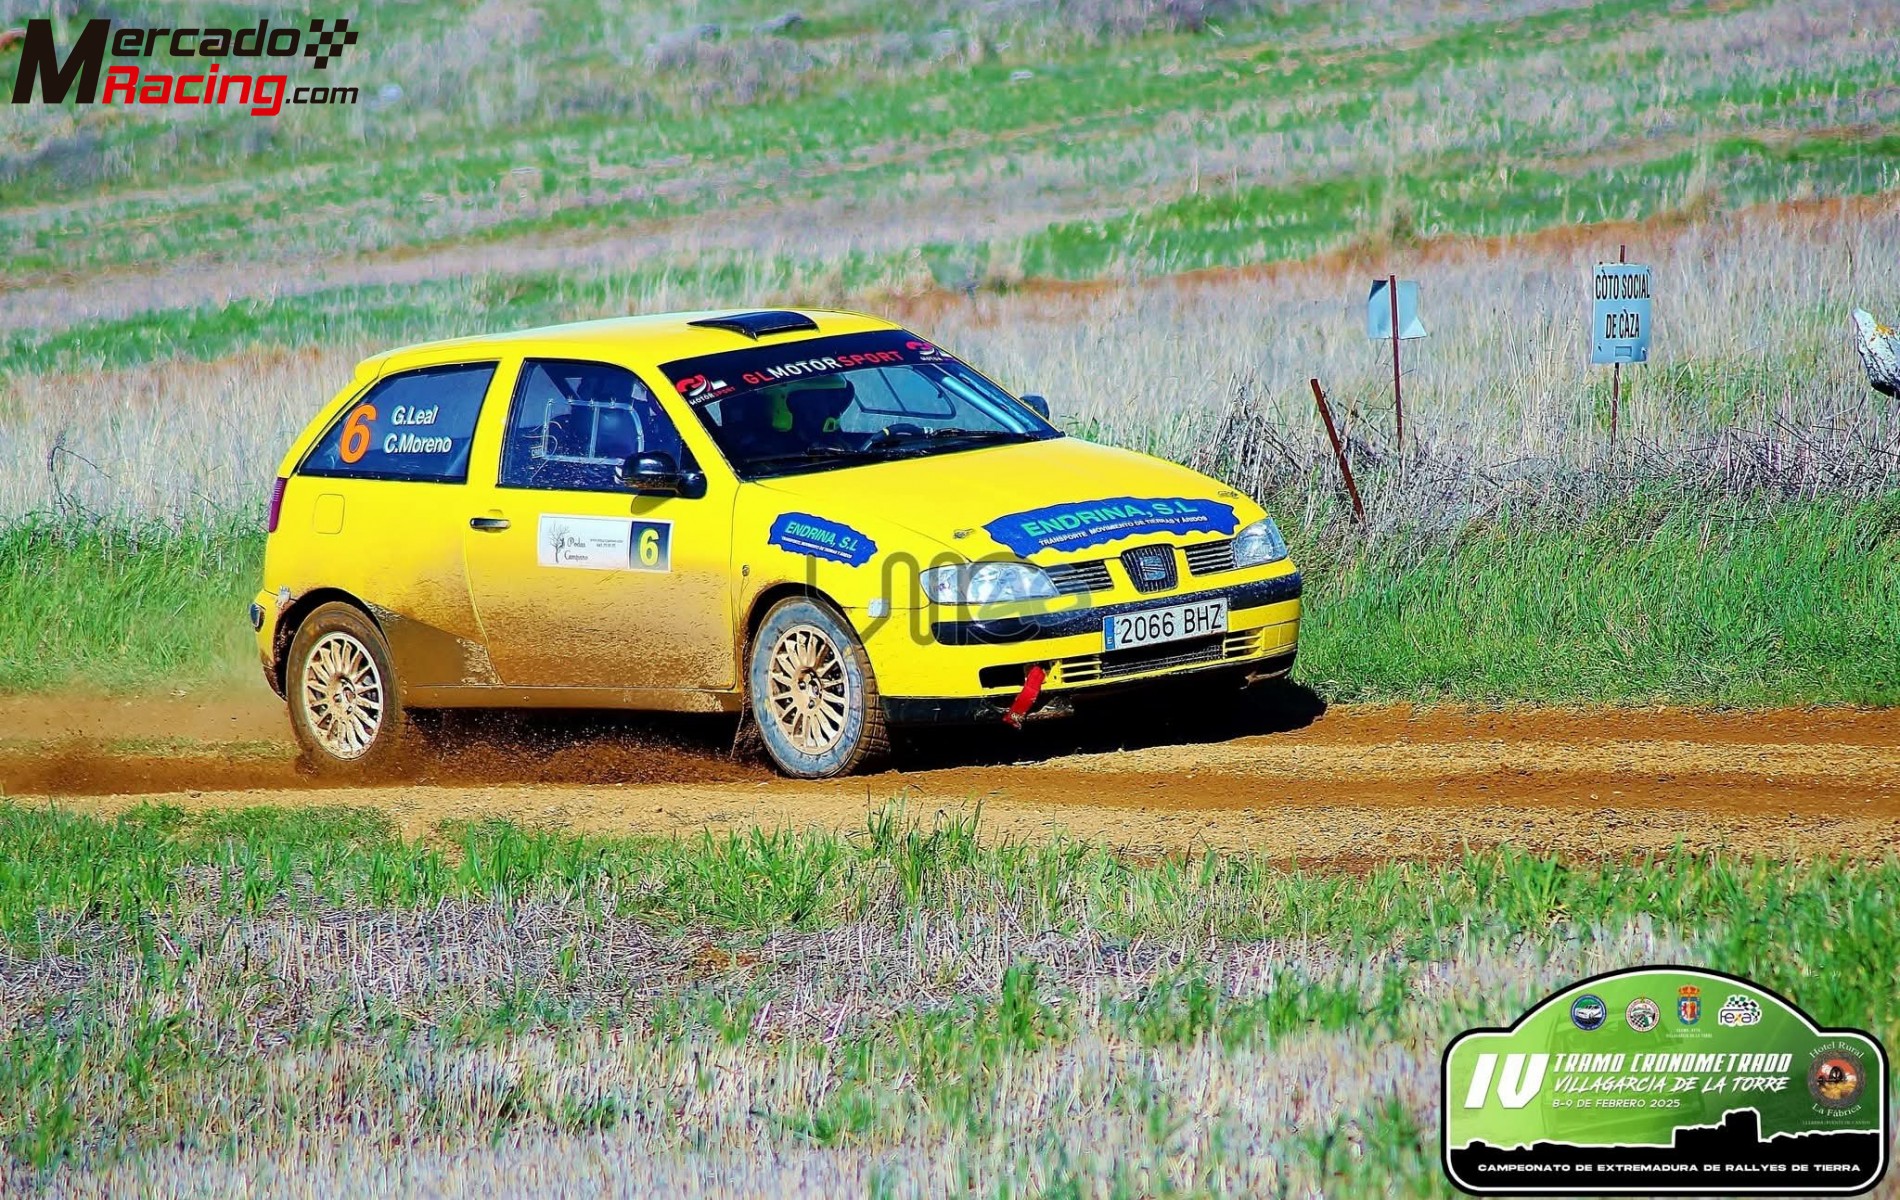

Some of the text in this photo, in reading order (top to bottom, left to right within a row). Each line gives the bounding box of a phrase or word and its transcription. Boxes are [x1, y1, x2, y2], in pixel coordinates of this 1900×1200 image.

[1622, 273, 1650, 299] SOCIAL
[1605, 313, 1617, 339] DE
[391, 404, 438, 426] G.Leal
[339, 402, 378, 465] 6
[384, 432, 453, 455] C.Moreno
[1038, 531, 1088, 546] TRANSPORTE
[1088, 520, 1134, 535] MOVIMIENTO
[639, 527, 660, 566] 6
[1120, 603, 1222, 644] 2066 BHZ
[1106, 636, 1113, 644] E
